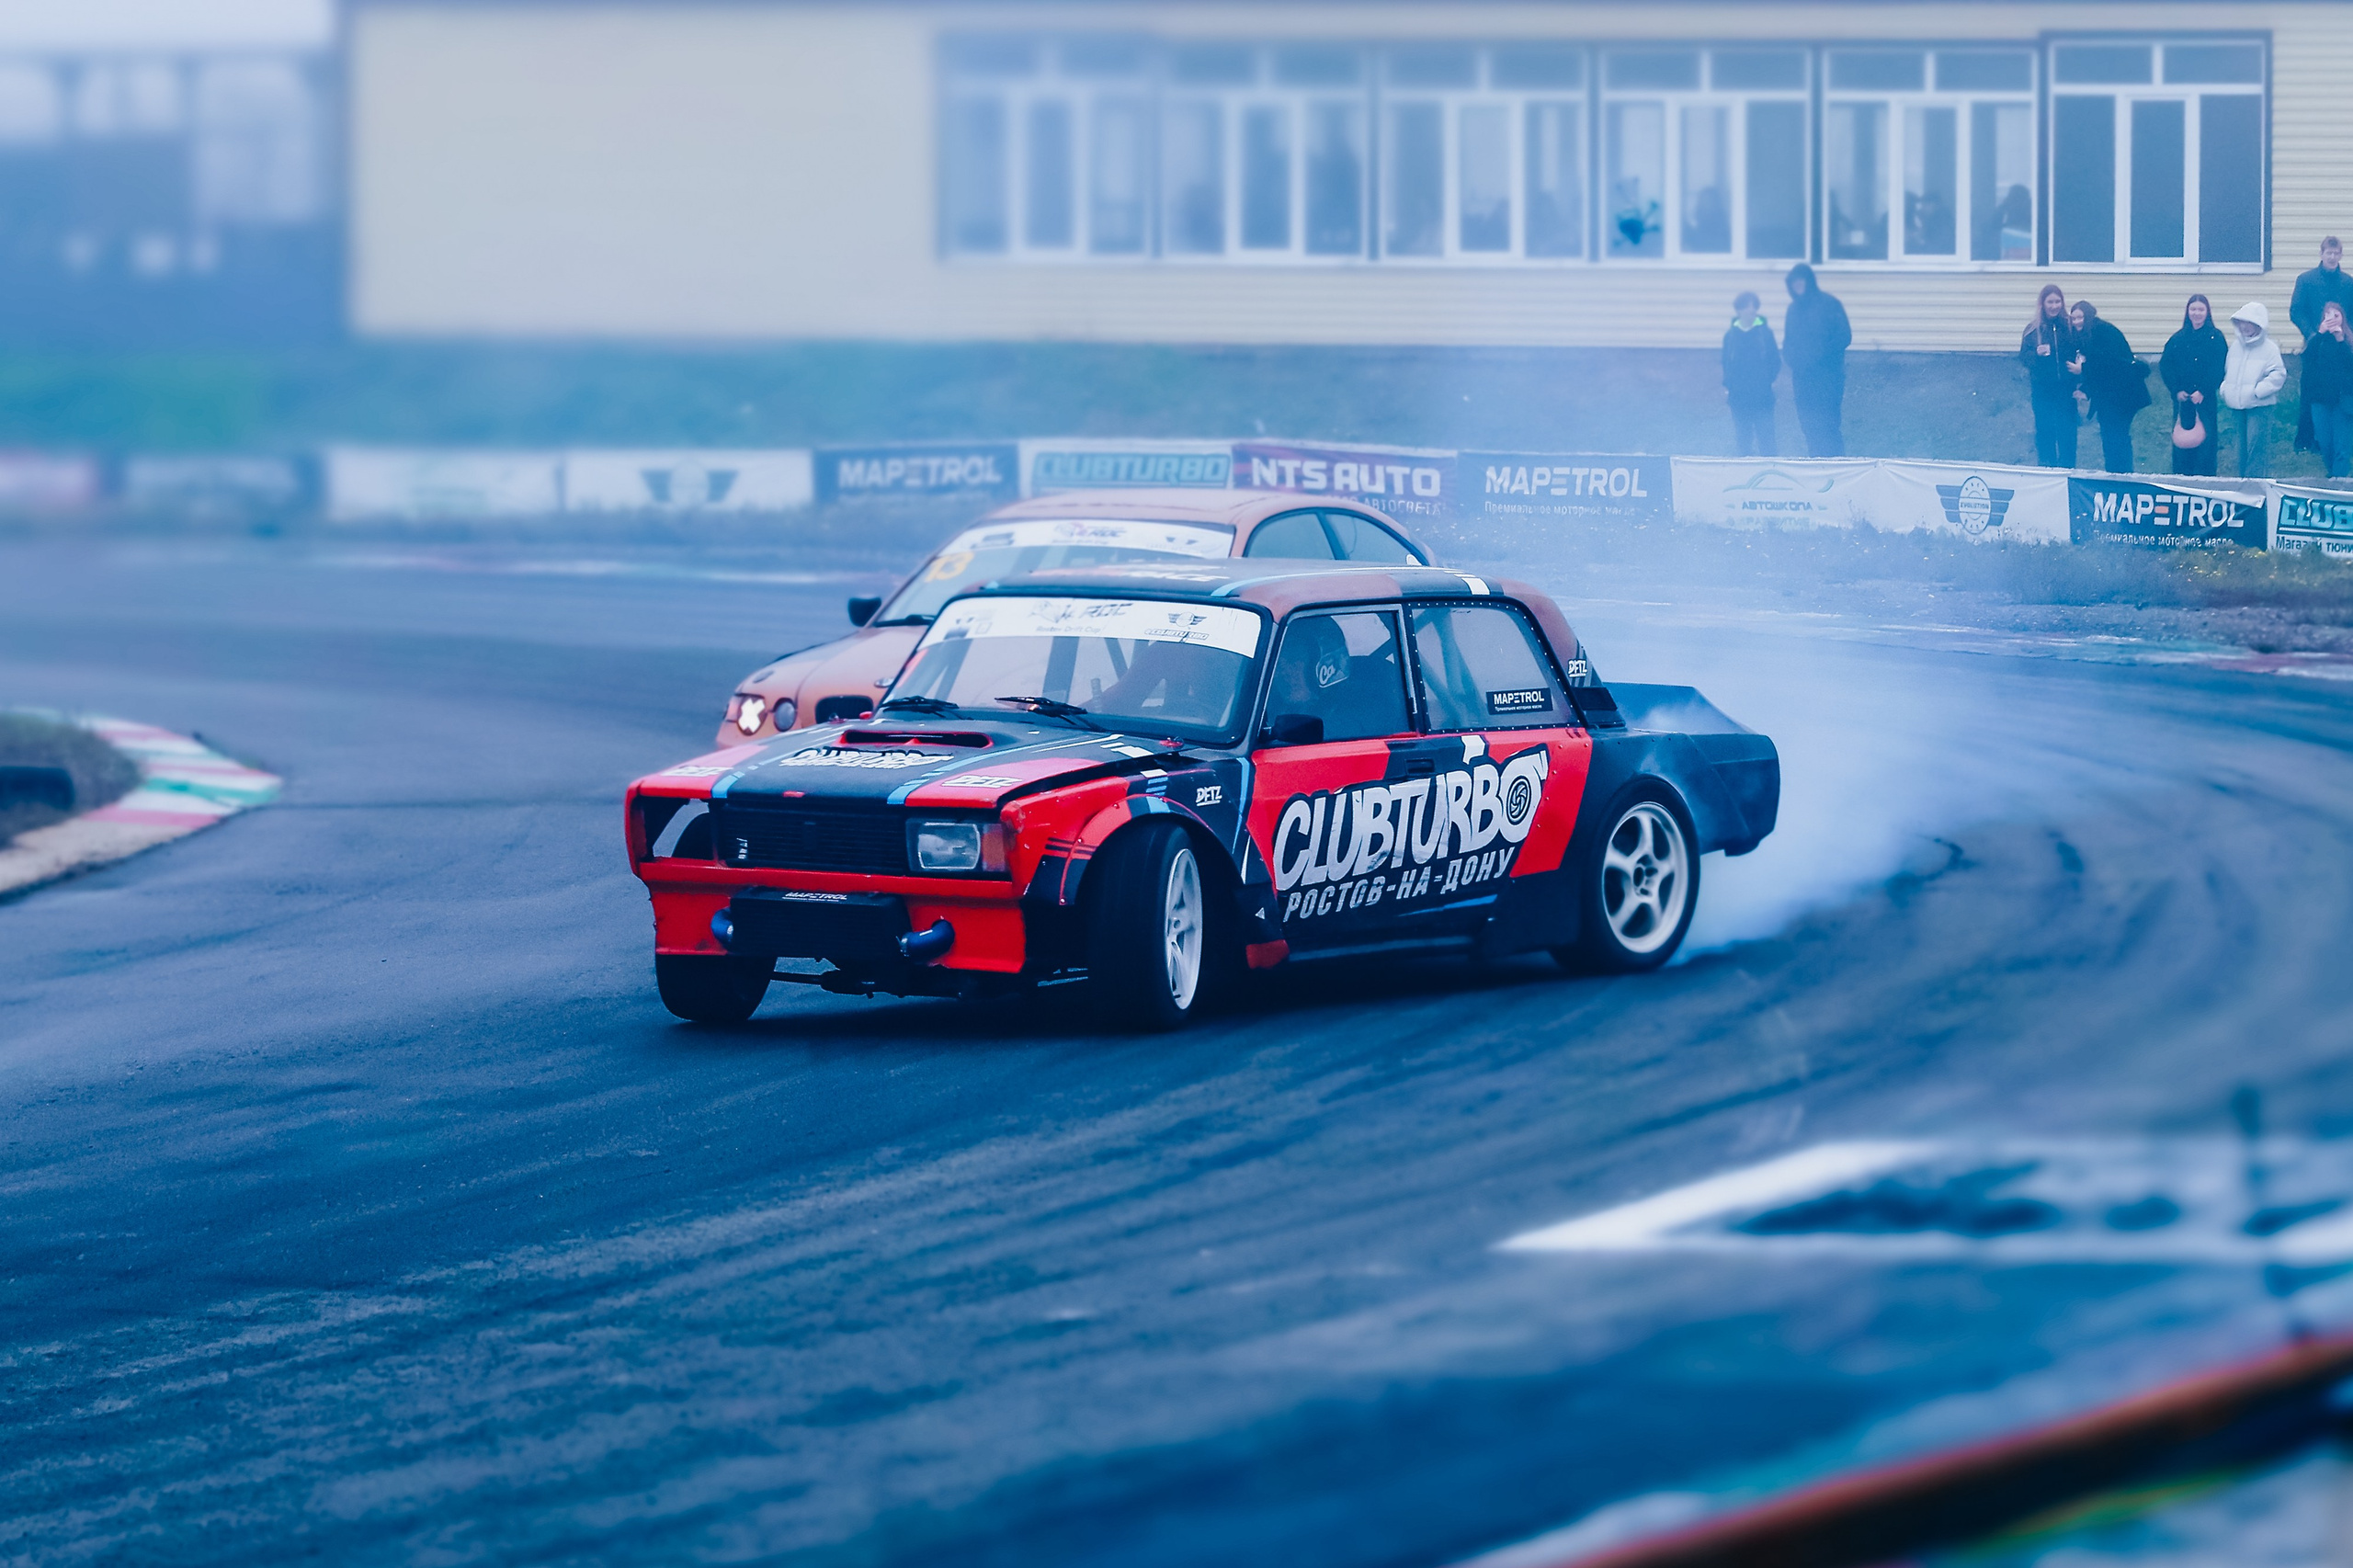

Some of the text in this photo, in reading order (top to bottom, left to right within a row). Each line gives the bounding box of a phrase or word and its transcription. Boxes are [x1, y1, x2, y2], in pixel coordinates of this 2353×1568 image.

[839, 457, 1001, 488] MAPETROL
[1038, 455, 1230, 485] CLUBTURBO
[1252, 458, 1441, 497] NTS AUTO
[1485, 466, 1647, 497] MAPETROL
[2093, 492, 2245, 528] MAPETROL
[1494, 691, 1544, 705] MAPETROL
[1273, 750, 1550, 891] CLUBTURBO
[784, 892, 847, 900] MAPETROL
